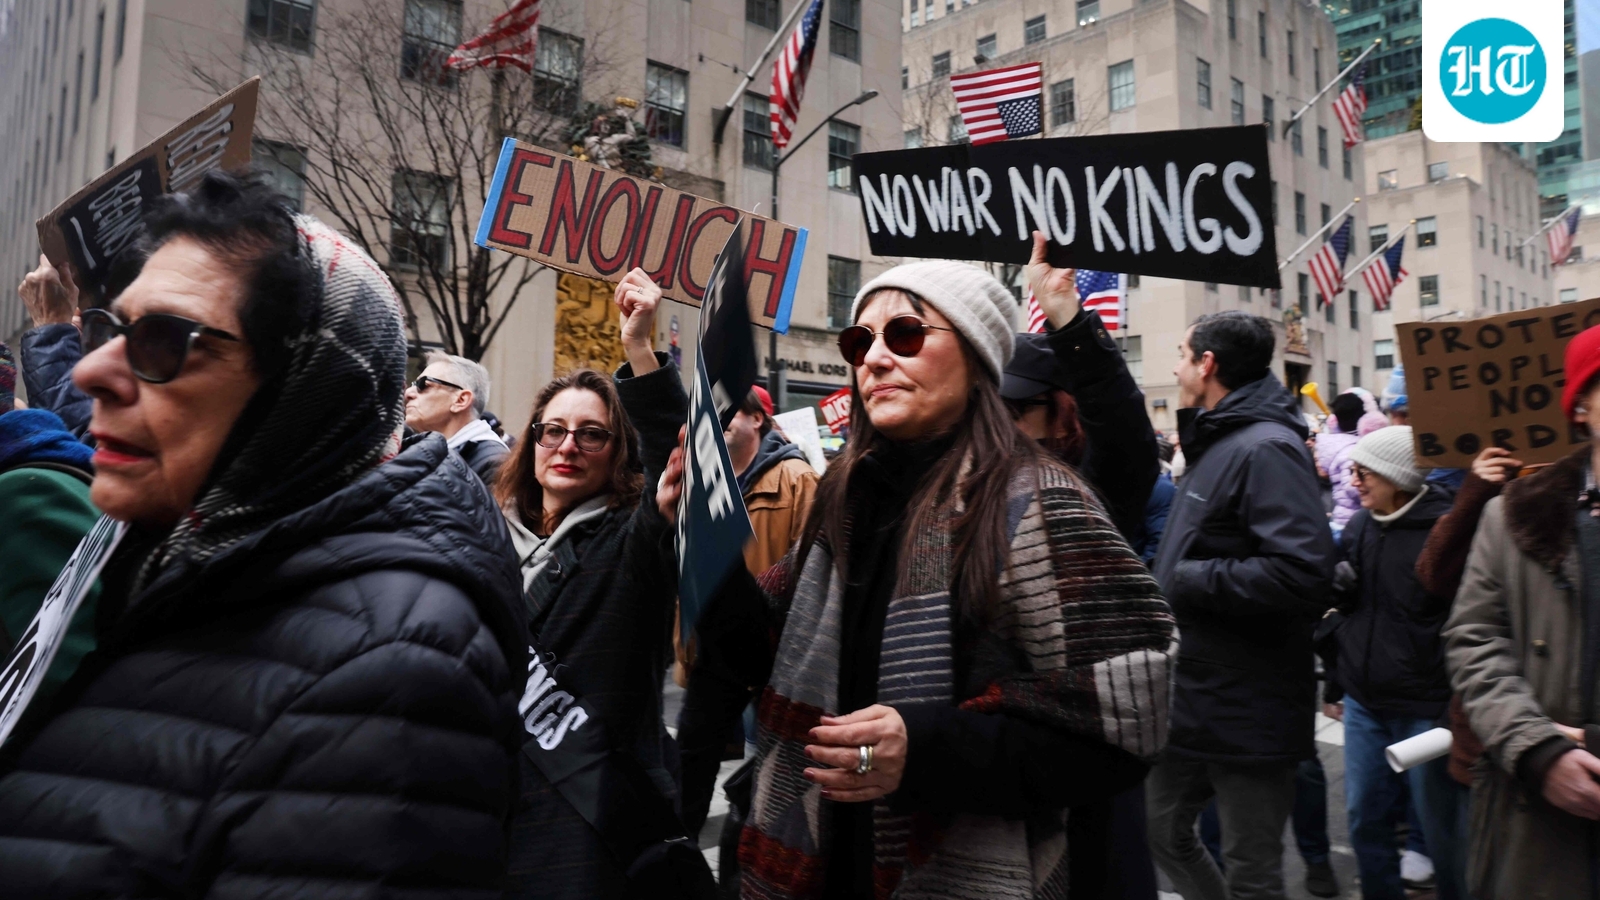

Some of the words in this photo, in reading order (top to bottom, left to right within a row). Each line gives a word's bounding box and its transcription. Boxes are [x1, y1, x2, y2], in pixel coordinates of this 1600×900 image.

[487, 148, 797, 318] ENOUGH
[859, 173, 916, 238] NO
[913, 166, 1001, 237] WAR
[1008, 164, 1076, 246] NO
[1085, 161, 1264, 256] KINGS
[818, 363, 847, 377] KORS
